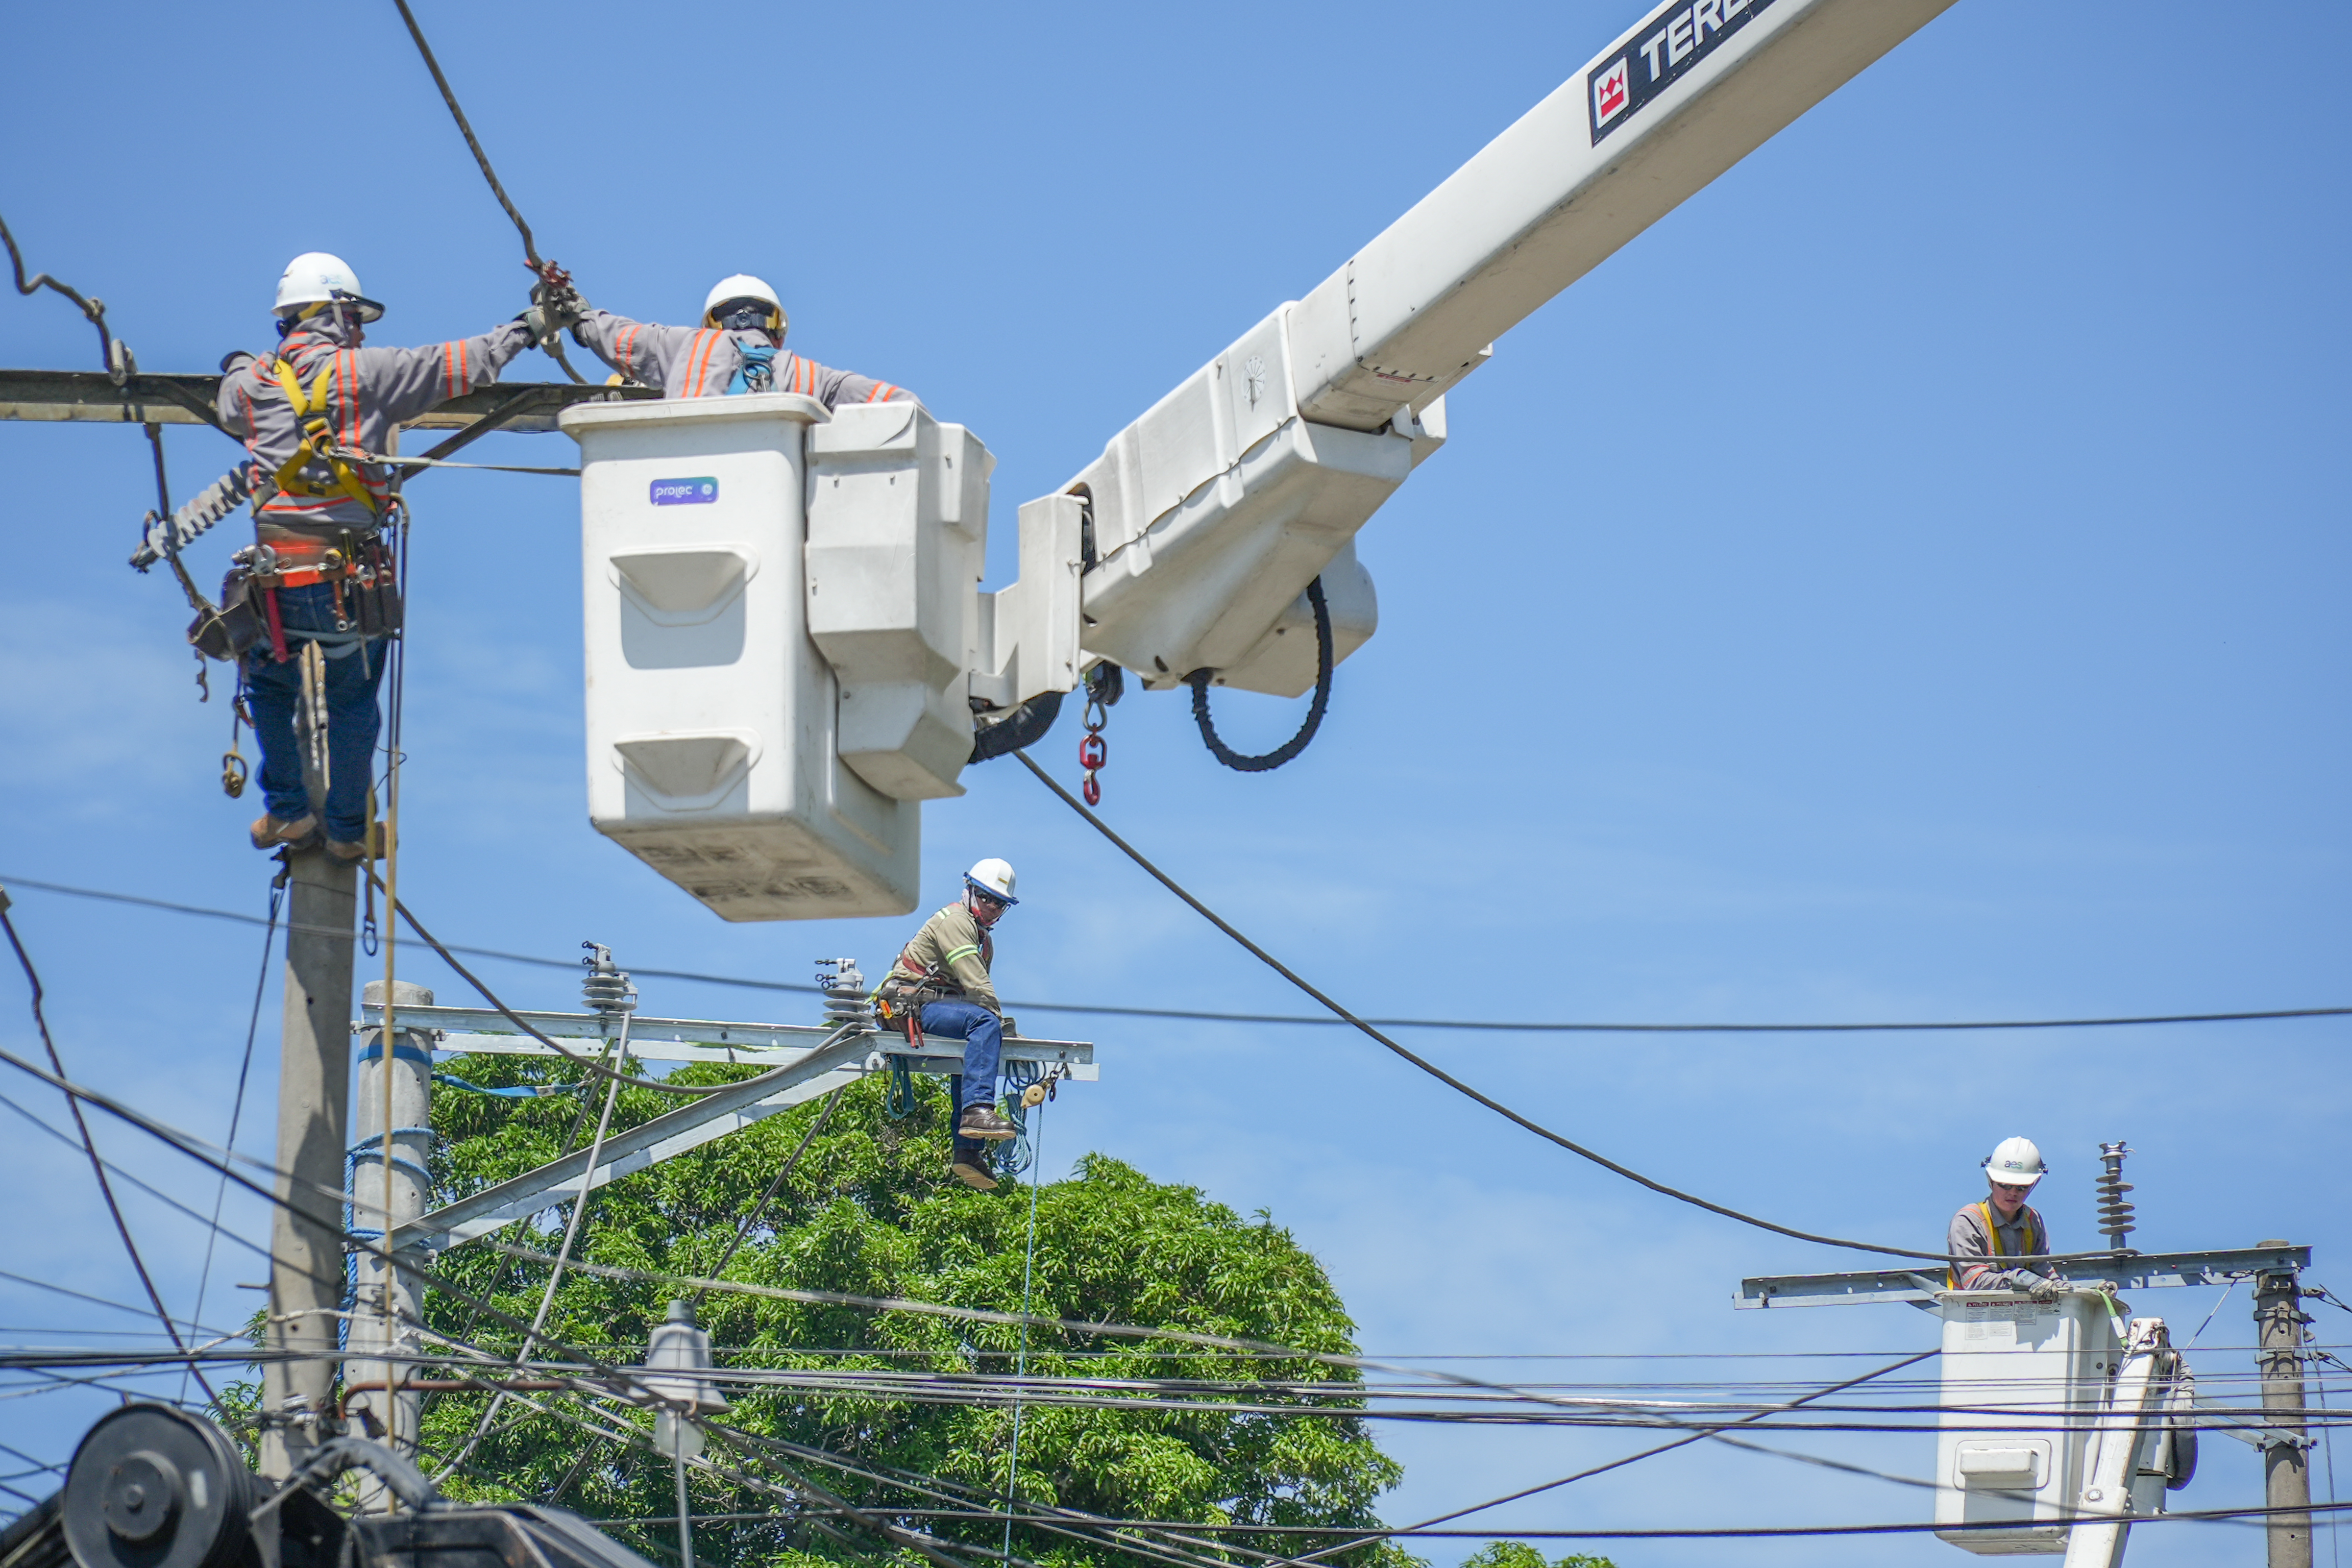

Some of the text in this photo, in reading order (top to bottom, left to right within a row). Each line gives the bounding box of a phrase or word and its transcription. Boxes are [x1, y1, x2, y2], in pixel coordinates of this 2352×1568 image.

[320, 275, 344, 284] aes
[656, 486, 693, 499] prolec
[2004, 1160, 2023, 1169] aes
